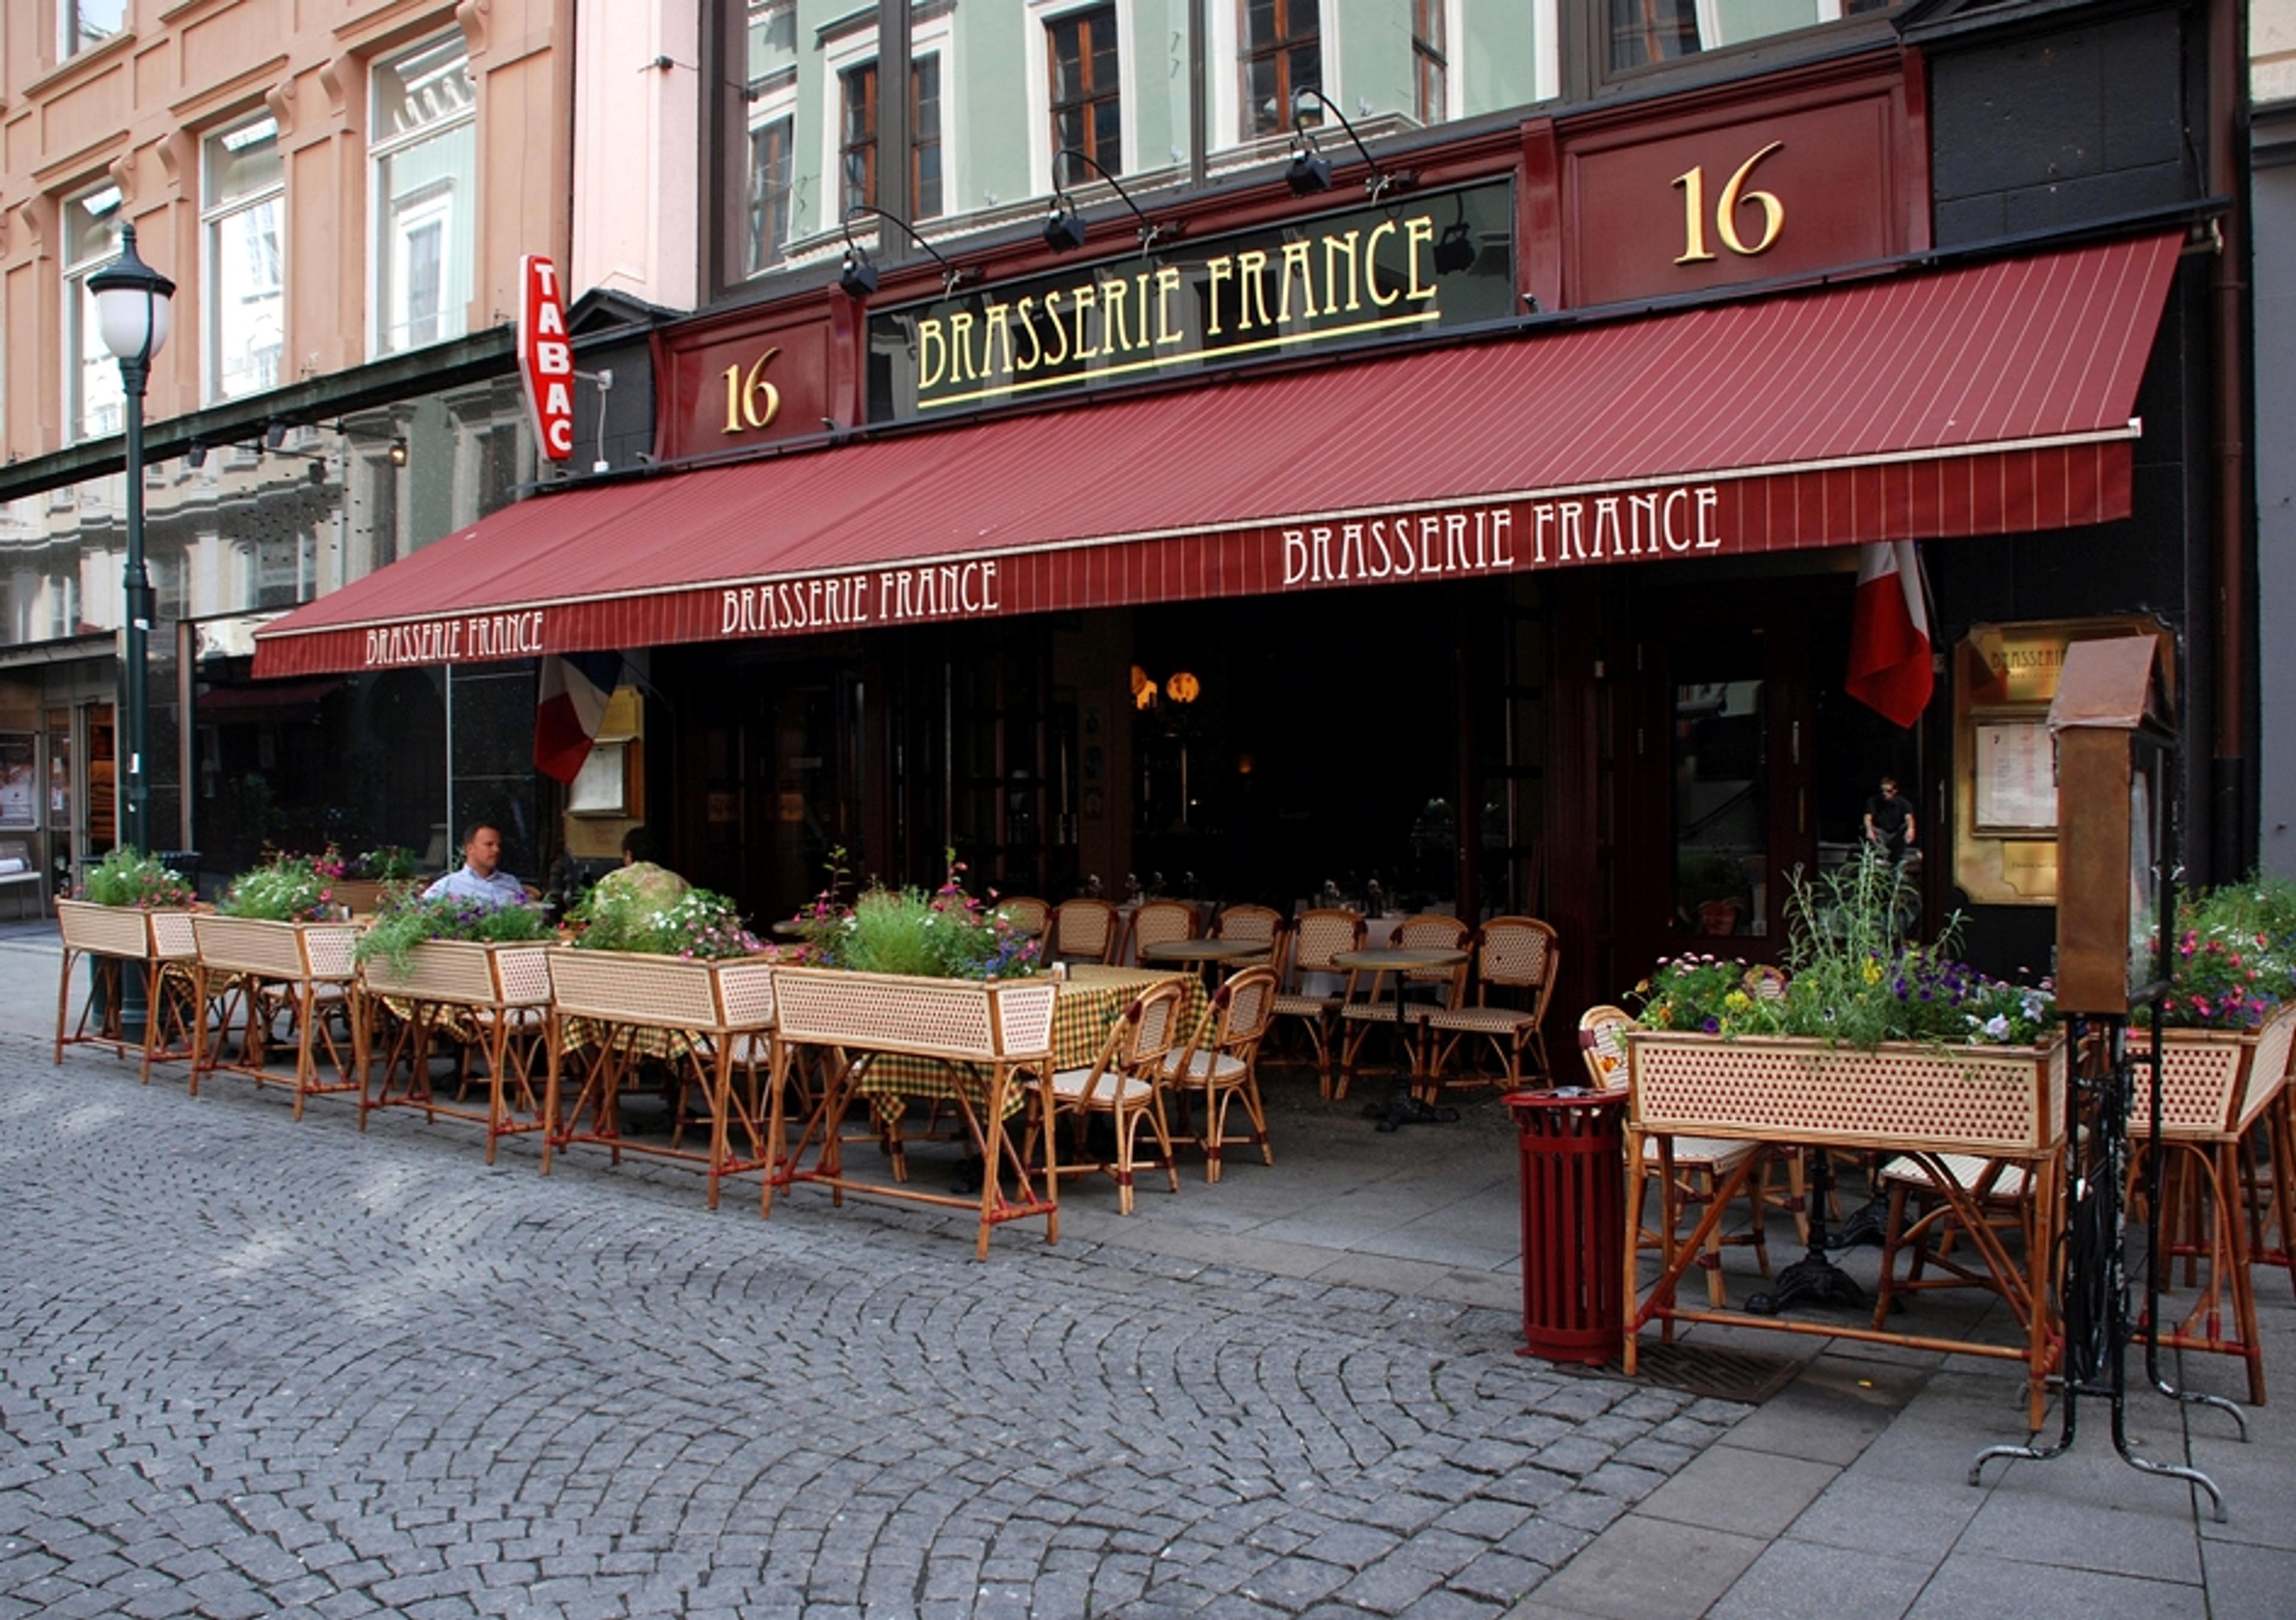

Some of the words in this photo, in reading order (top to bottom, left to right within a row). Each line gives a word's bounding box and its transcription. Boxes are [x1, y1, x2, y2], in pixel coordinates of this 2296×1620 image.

[1671, 140, 1784, 264] 16
[918, 267, 1183, 390] BRASSERIE
[1207, 216, 1437, 335] FRANCE
[535, 263, 572, 451] TABAC
[720, 347, 780, 433] 16
[1283, 509, 1515, 585] BRASSERIE
[1533, 487, 1721, 563] FRANCE
[365, 620, 461, 665] BRASSERIE
[468, 611, 544, 657] FRANCE
[721, 576, 868, 634] BRASSERIE
[879, 561, 999, 619] FRANCE
